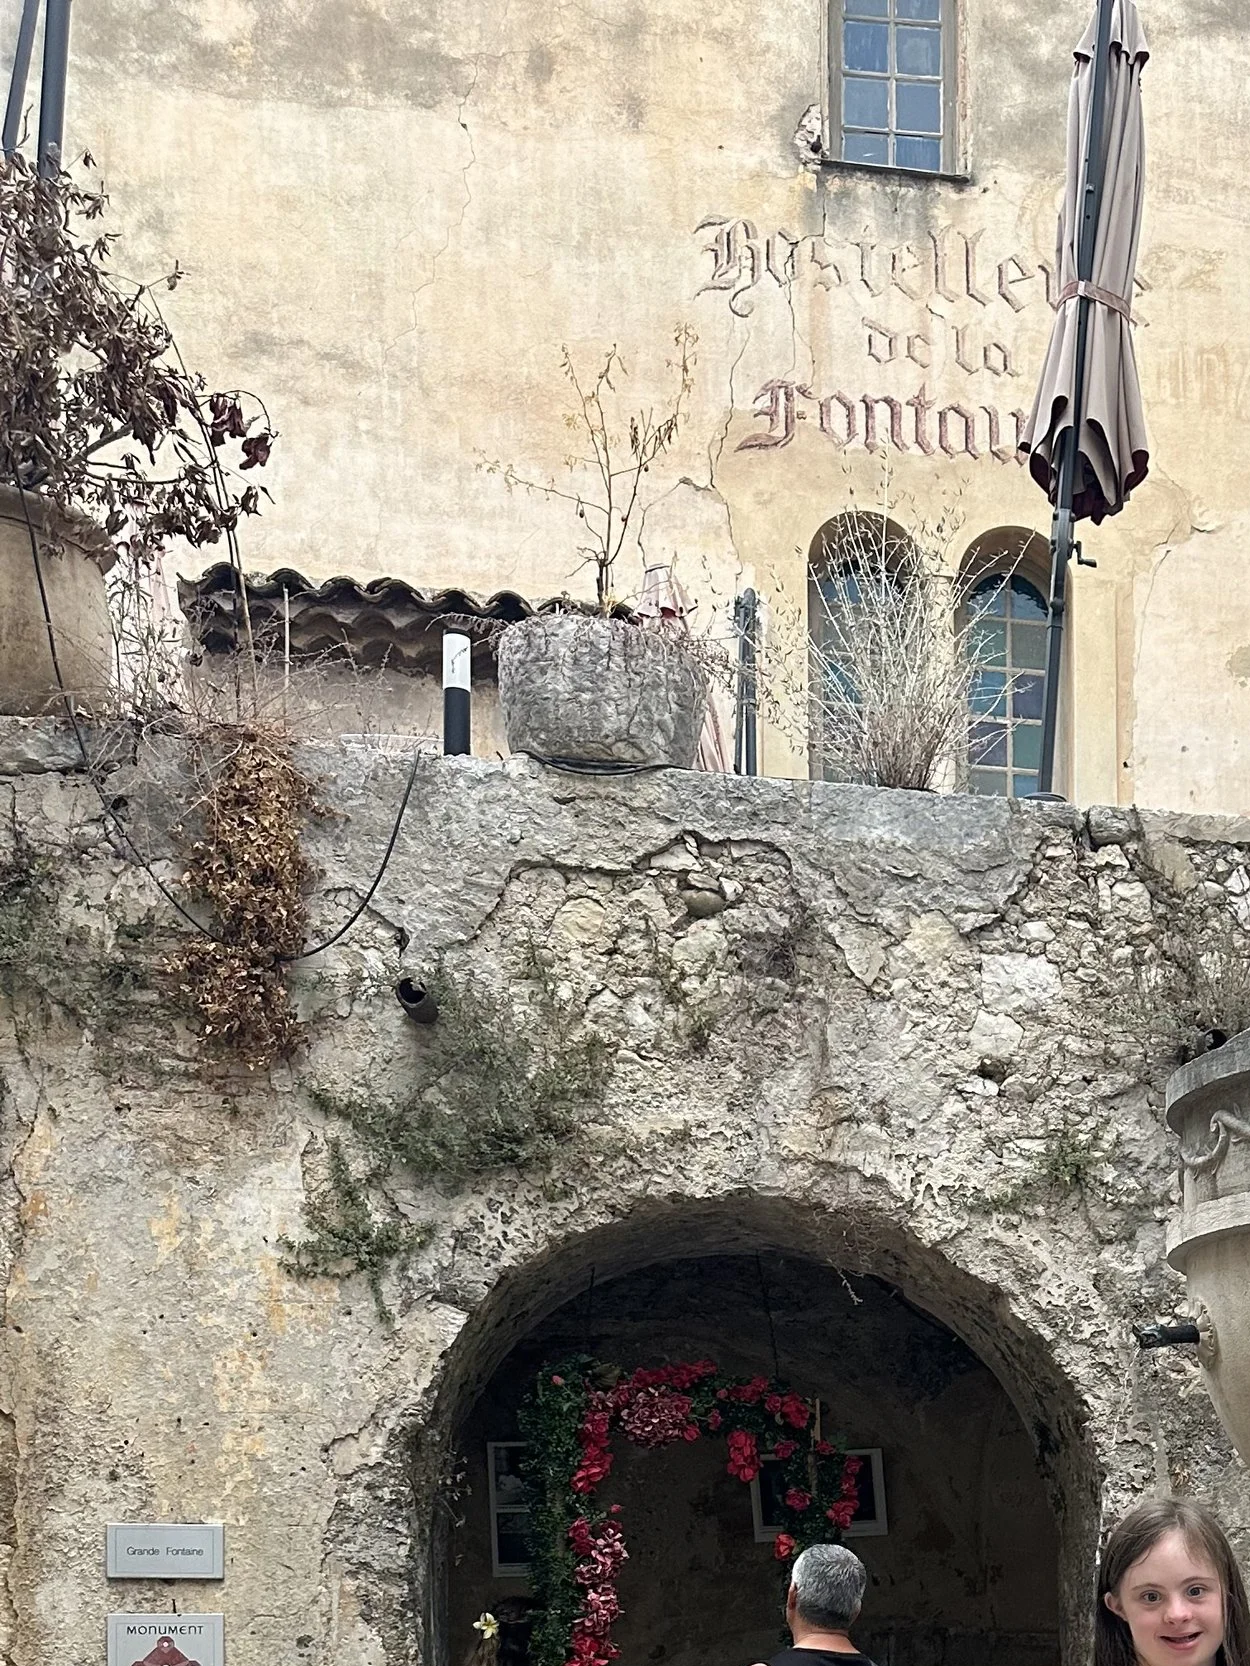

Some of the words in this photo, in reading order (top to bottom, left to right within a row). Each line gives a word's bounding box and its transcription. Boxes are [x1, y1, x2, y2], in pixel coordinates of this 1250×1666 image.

[861, 316, 932, 370] de
[950, 323, 1023, 378] la
[126, 1546, 161, 1556] Grande
[165, 1546, 204, 1557] Fontaine
[126, 1625, 205, 1636] MONUMENT
